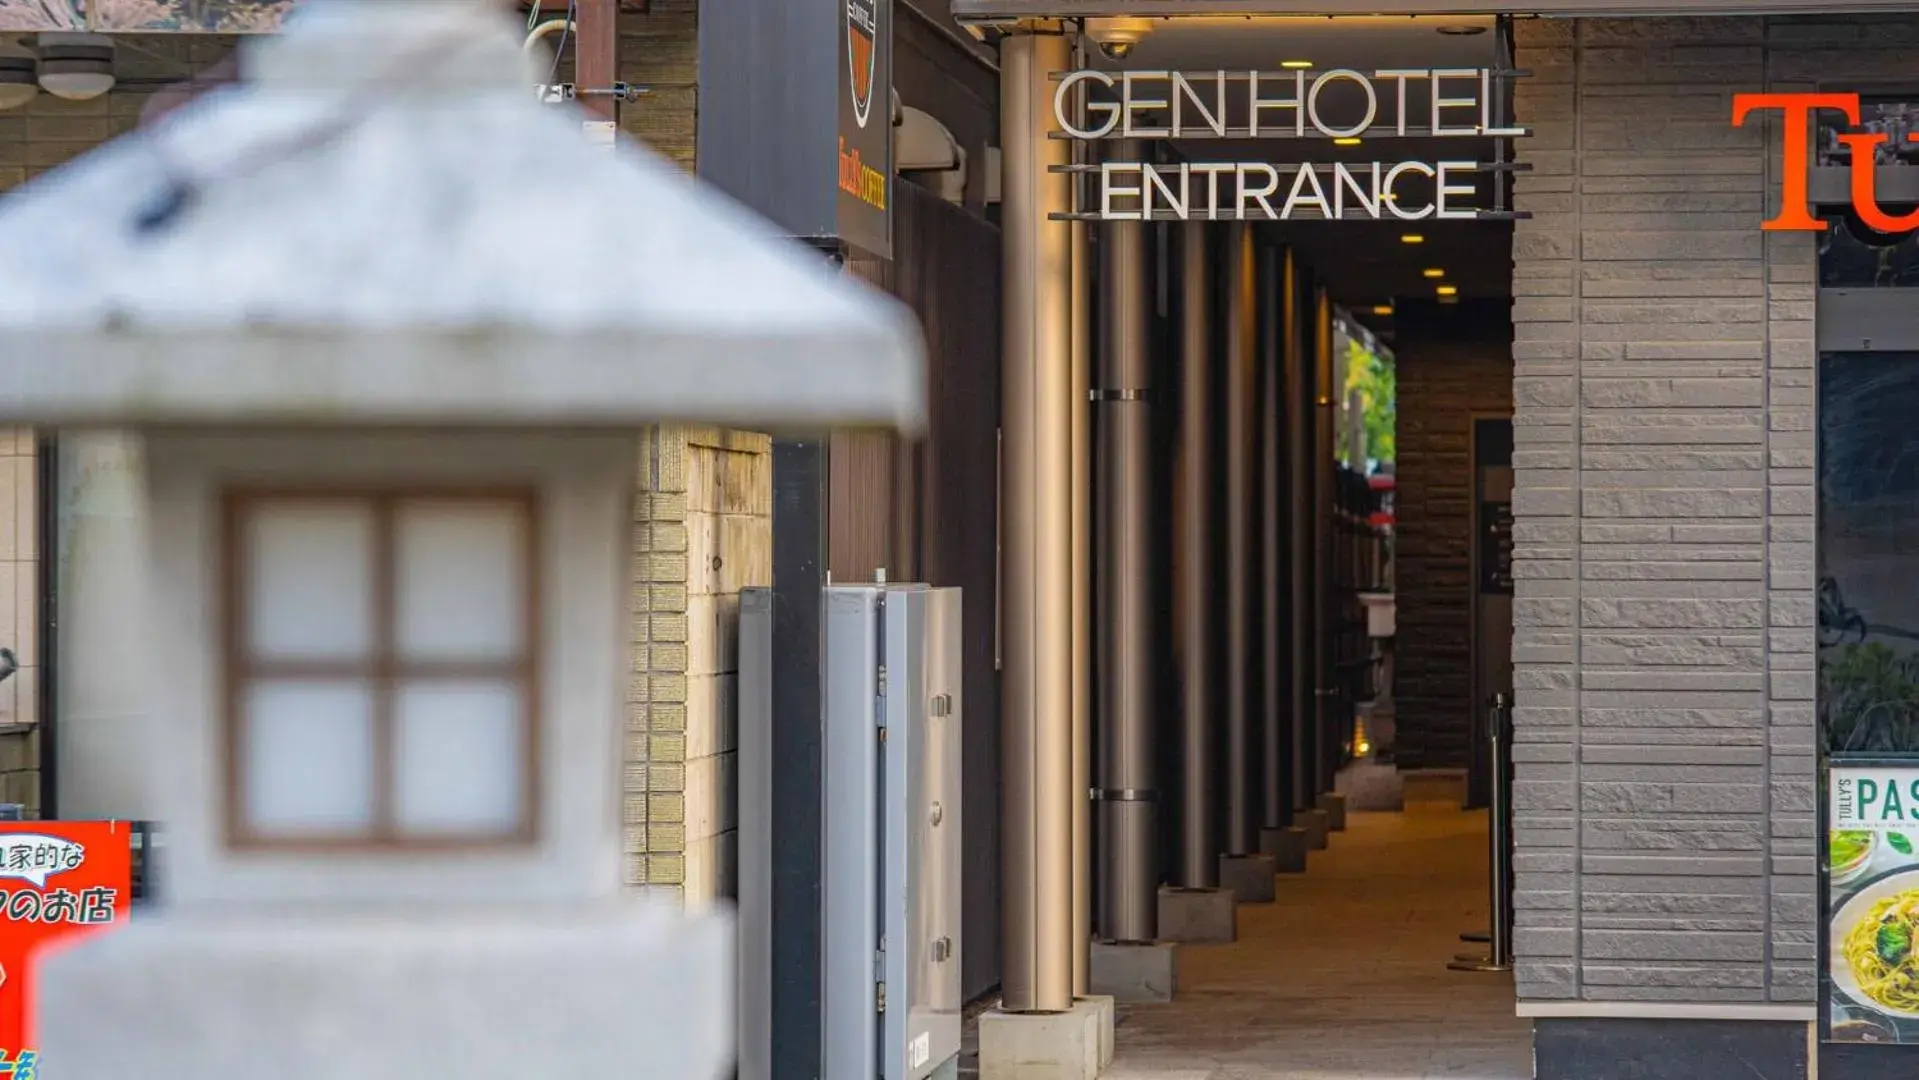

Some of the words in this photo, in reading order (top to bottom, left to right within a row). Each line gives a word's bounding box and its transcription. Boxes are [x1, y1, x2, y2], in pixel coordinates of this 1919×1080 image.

[1053, 69, 1226, 138] GEN
[1249, 68, 1526, 138] HOTEL
[861, 164, 885, 210] COFFEE
[1100, 160, 1478, 220] ENTRANCE
[1838, 778, 1852, 819] TULLY'S
[0, 843, 84, 869] 家的な
[0, 887, 116, 922] のお店
